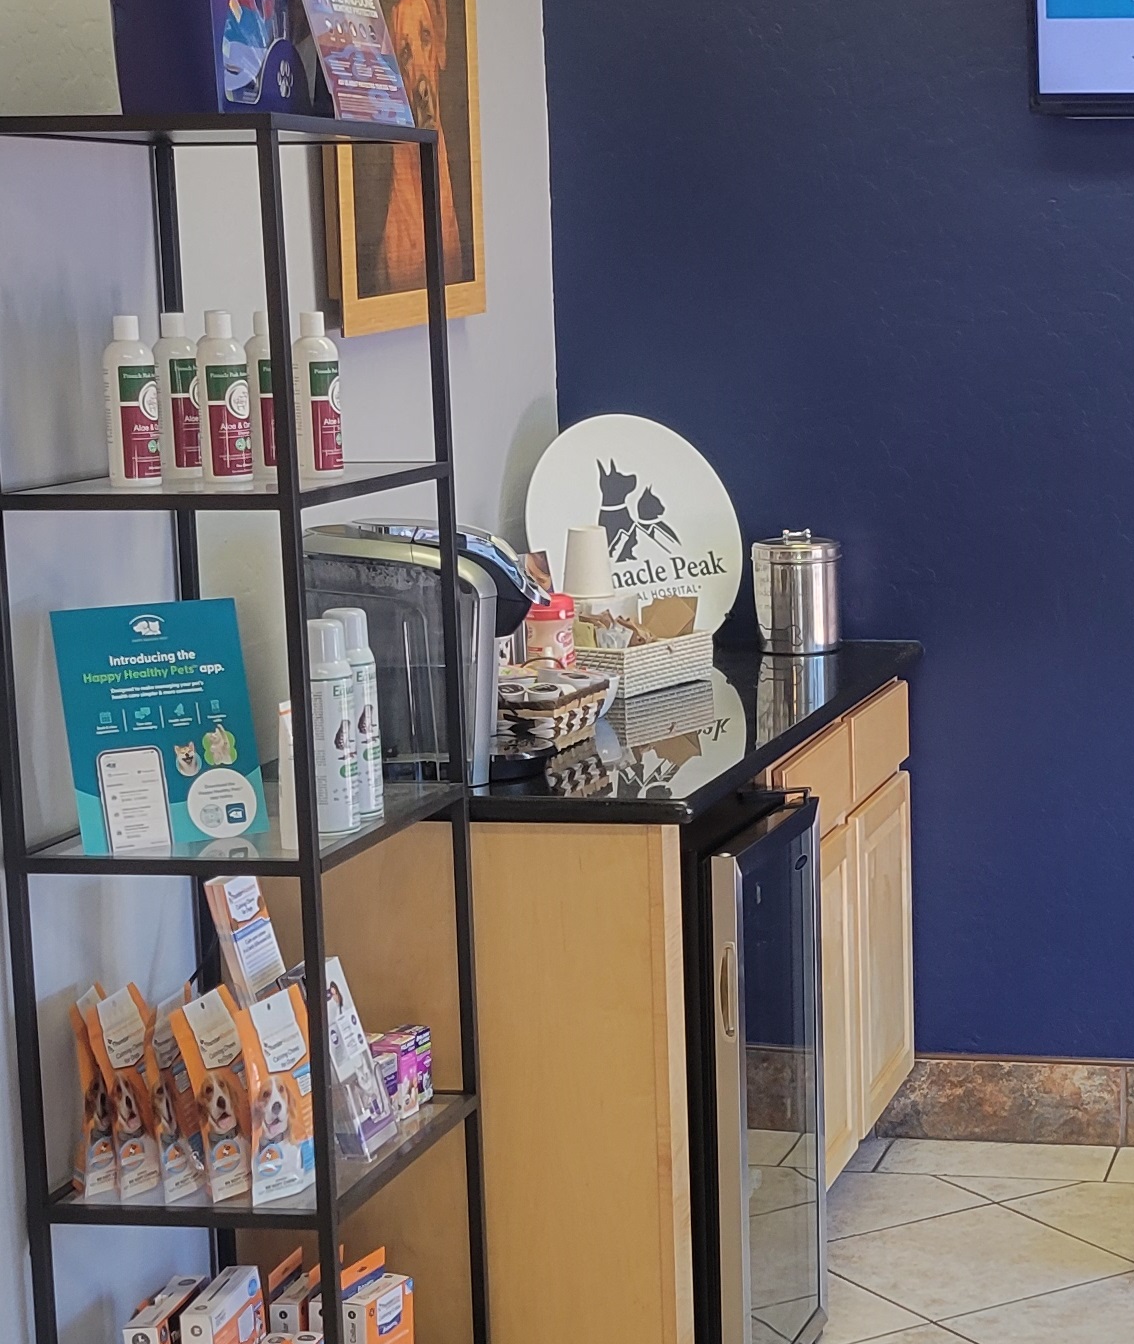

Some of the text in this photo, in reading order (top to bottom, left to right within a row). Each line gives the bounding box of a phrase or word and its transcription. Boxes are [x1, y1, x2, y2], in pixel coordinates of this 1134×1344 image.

[611, 550, 728, 589] nacle Peak
[109, 649, 196, 667] Introducing the
[83, 672, 121, 684] Happy
[124, 667, 168, 681] Healthy
[199, 663, 225, 675] app.
